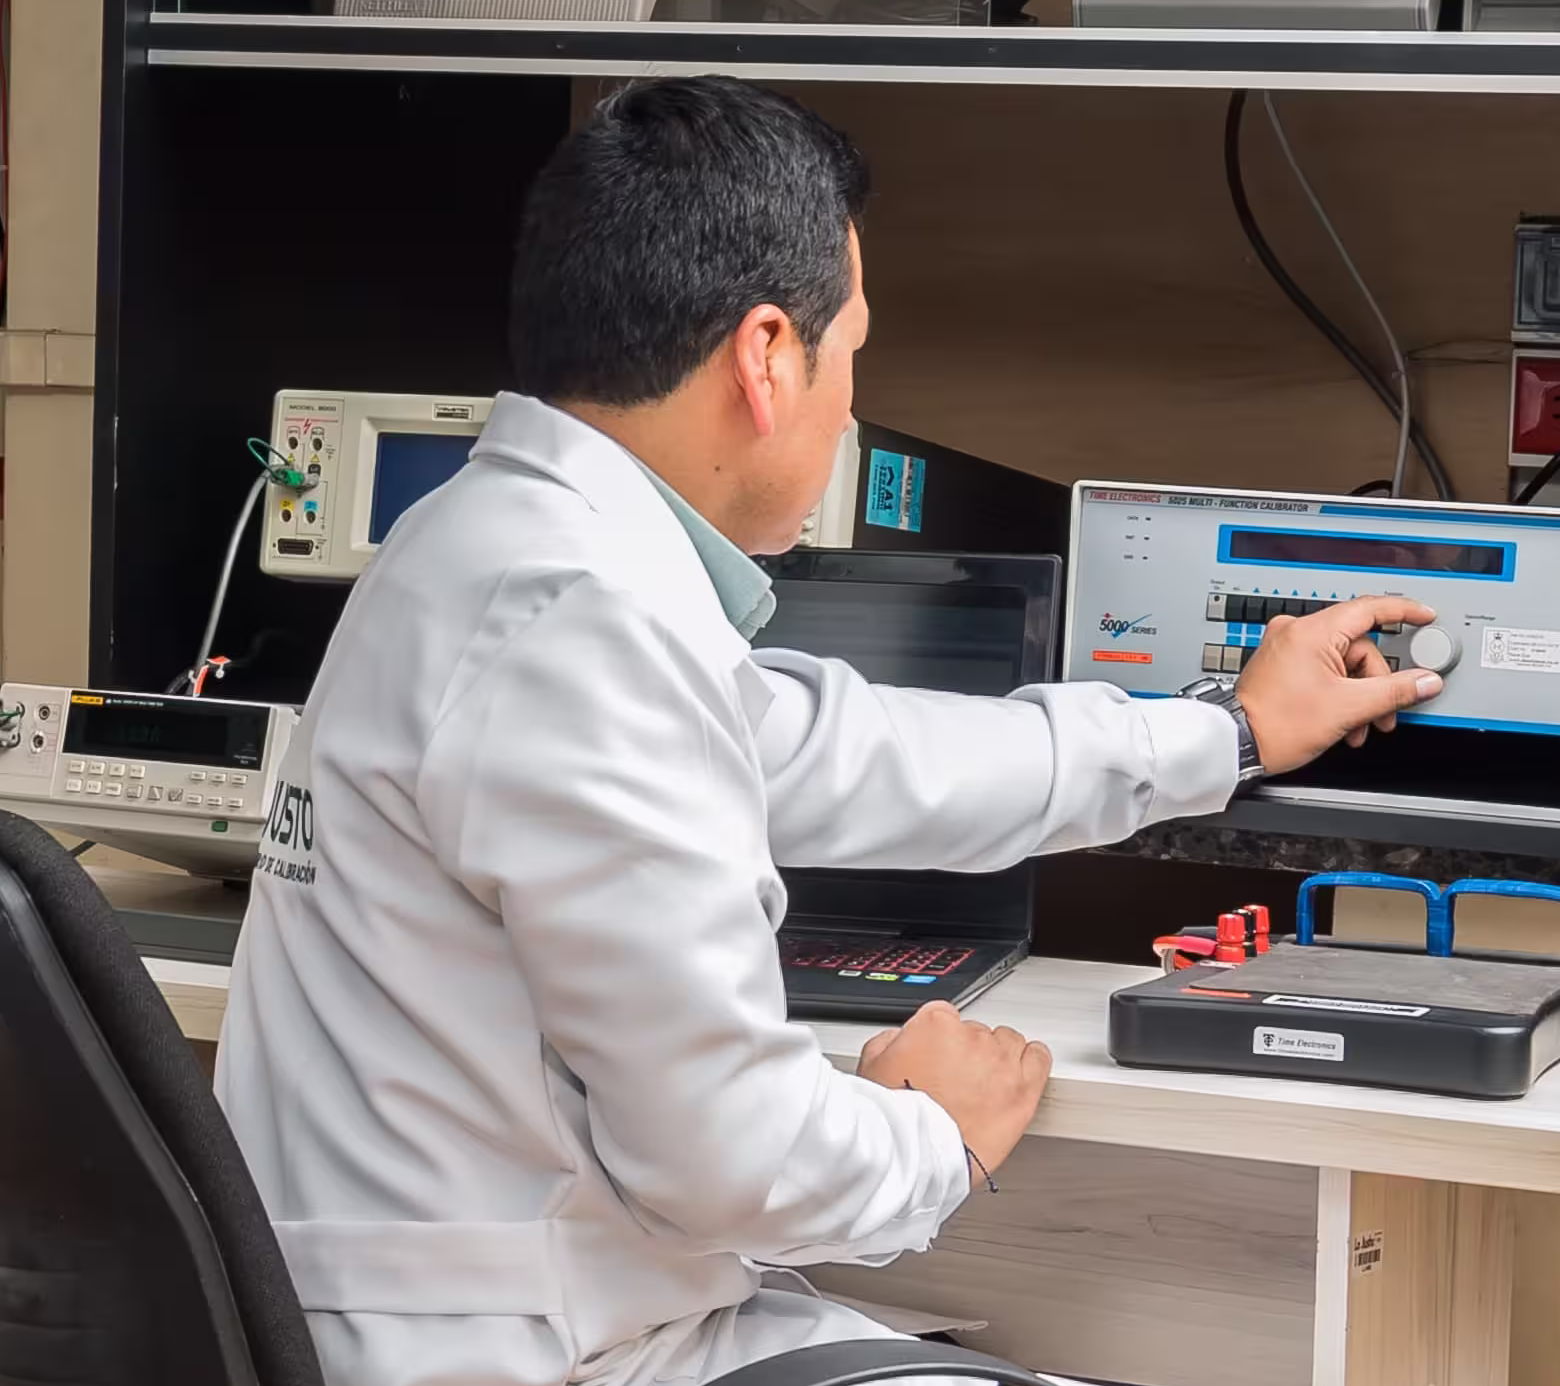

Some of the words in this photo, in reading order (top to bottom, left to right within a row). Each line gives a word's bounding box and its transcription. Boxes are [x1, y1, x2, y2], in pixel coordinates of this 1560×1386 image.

[288, 404, 316, 412] MODEL
[1088, 490, 1108, 501] TIME
[1109, 492, 1161, 504] ELECTRONICS
[1188, 497, 1213, 508] MULTI
[1219, 498, 1258, 510] FUNCTION
[1260, 501, 1308, 513] CALIBRATOR
[1099, 618, 1130, 634] 5000
[1130, 626, 1157, 636] SERIES
[1277, 1037, 1296, 1047] Time
[1297, 1038, 1337, 1051] Electronics
